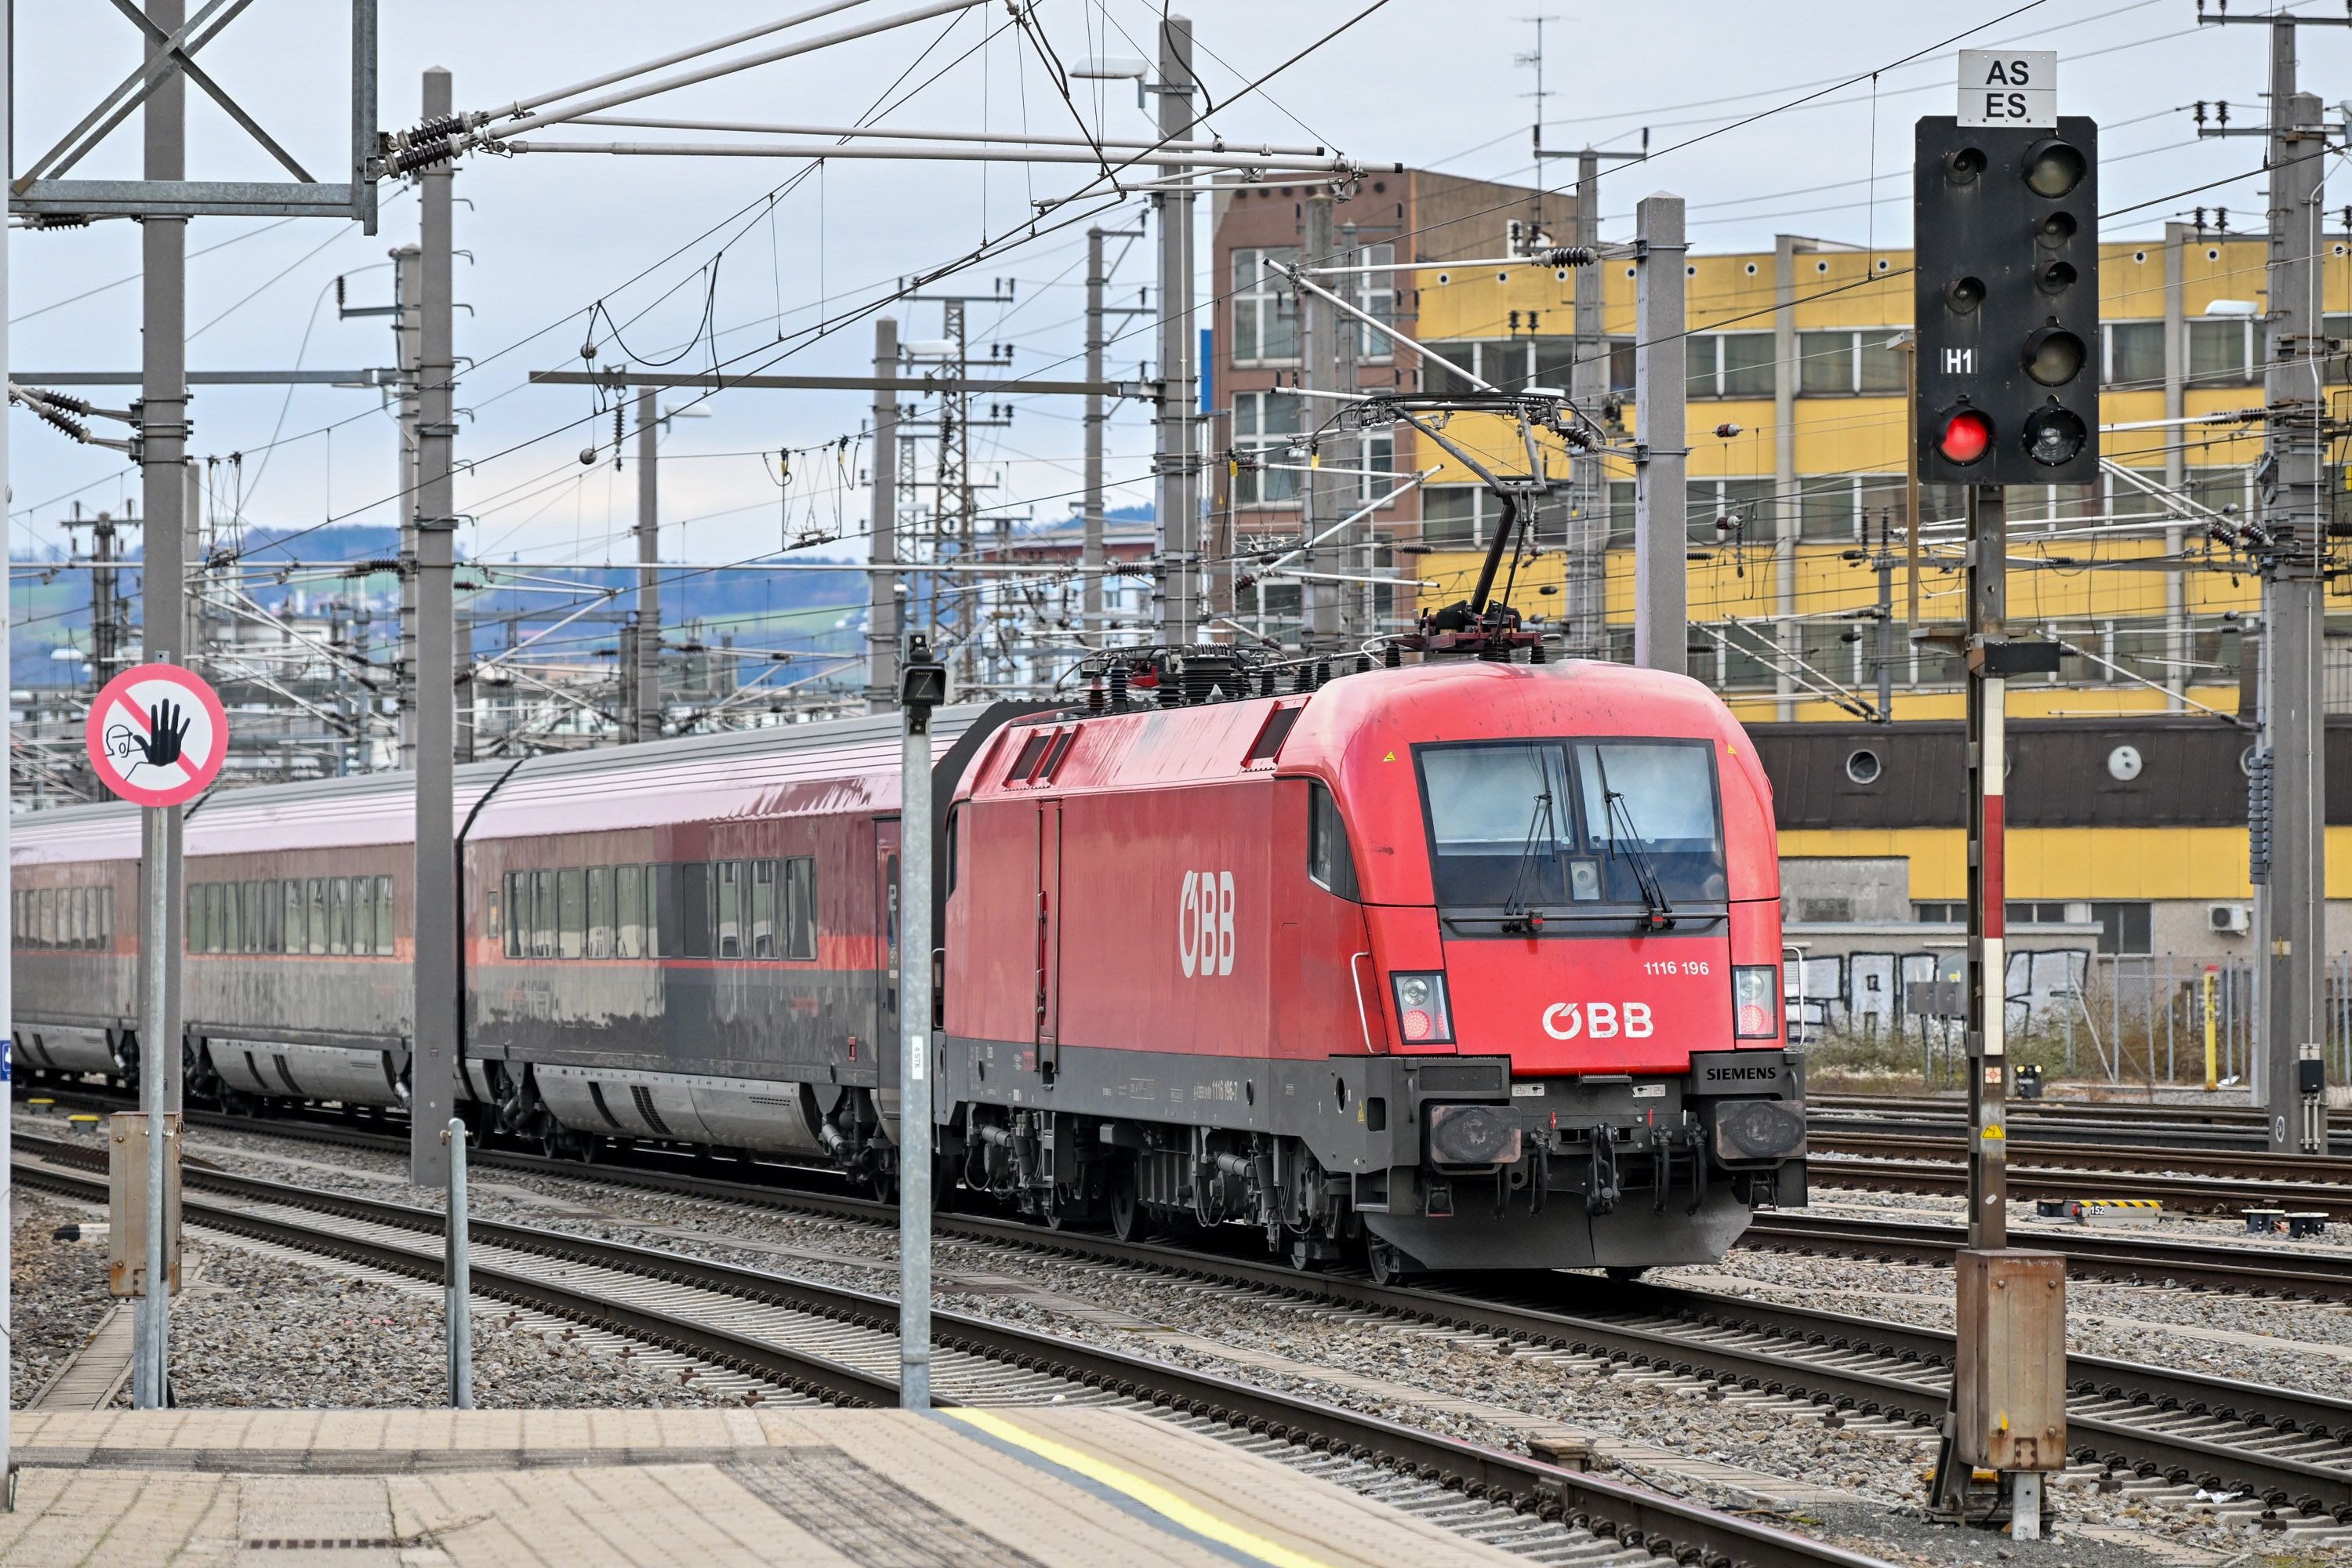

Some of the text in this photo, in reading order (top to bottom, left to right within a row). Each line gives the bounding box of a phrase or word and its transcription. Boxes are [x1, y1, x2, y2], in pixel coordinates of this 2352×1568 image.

[1986, 61, 2030, 85] AS
[1987, 93, 2027, 118] ES
[1946, 349, 1972, 374] H1
[1179, 869, 1235, 978] ÖBB
[1644, 961, 1709, 975] 1116 196
[1542, 1002, 1653, 1040] ÖBB
[1707, 1066, 1776, 1080] SIEMENS
[2090, 1206, 2105, 1215] 152
